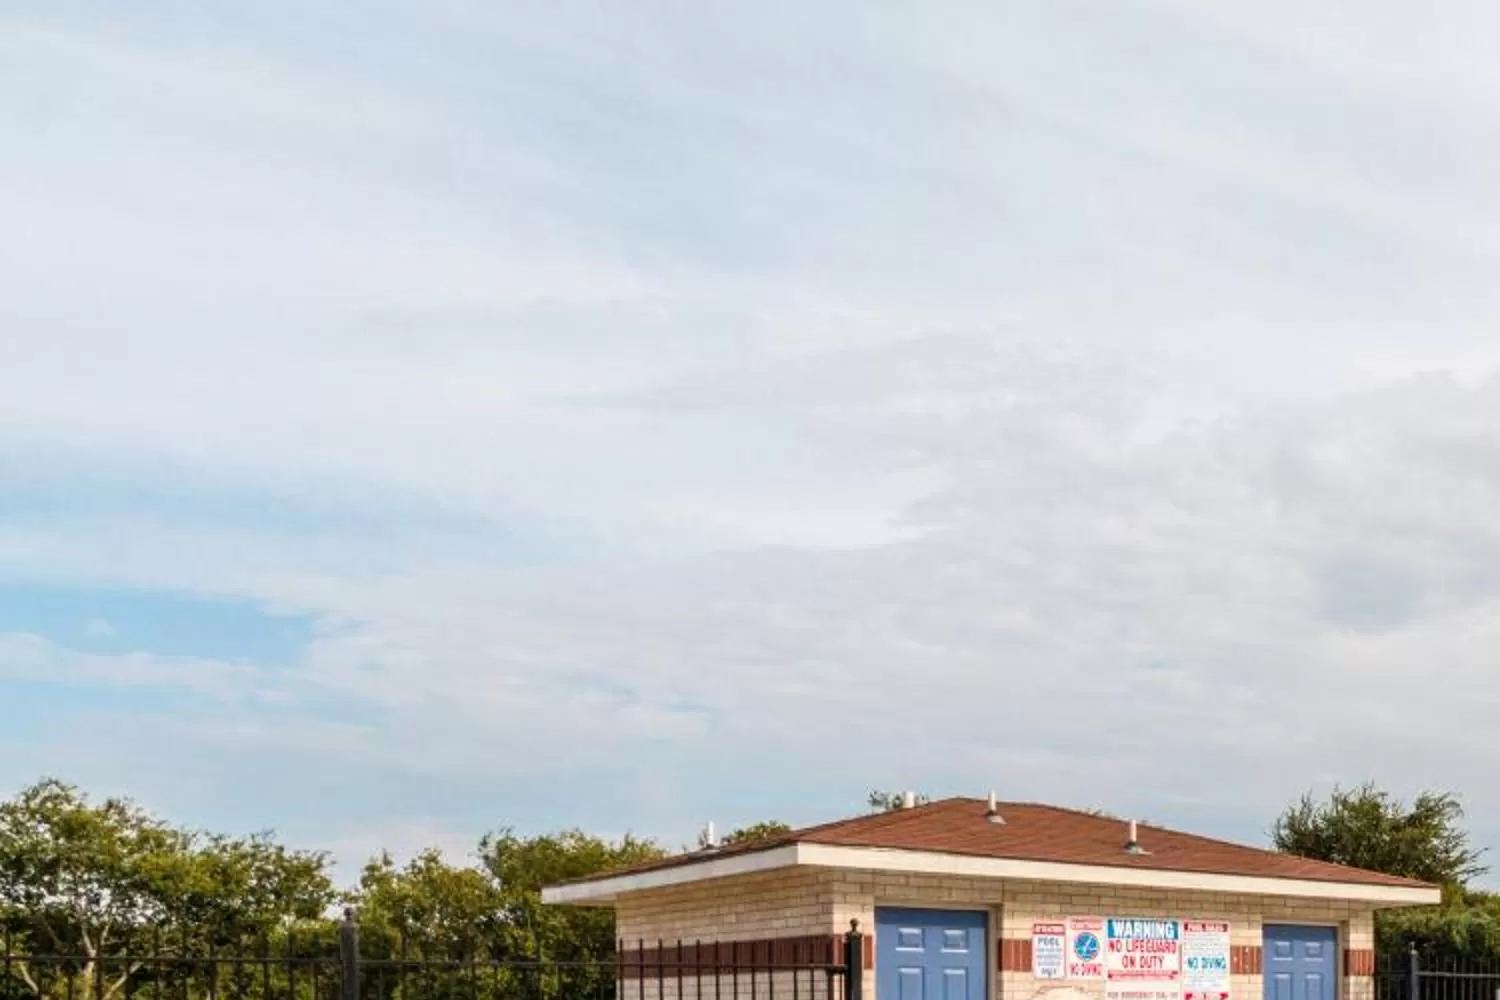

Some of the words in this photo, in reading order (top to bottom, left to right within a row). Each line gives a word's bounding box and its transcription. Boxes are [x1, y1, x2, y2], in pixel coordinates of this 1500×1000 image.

[1112, 921, 1177, 939] WARNING
[1108, 940, 1123, 952] NO
[1125, 939, 1177, 954] LIFEGUARD
[1121, 955, 1136, 968] ON
[1139, 955, 1165, 968] DUTY
[1187, 957, 1199, 969] NO
[1201, 956, 1227, 969] DIVING
